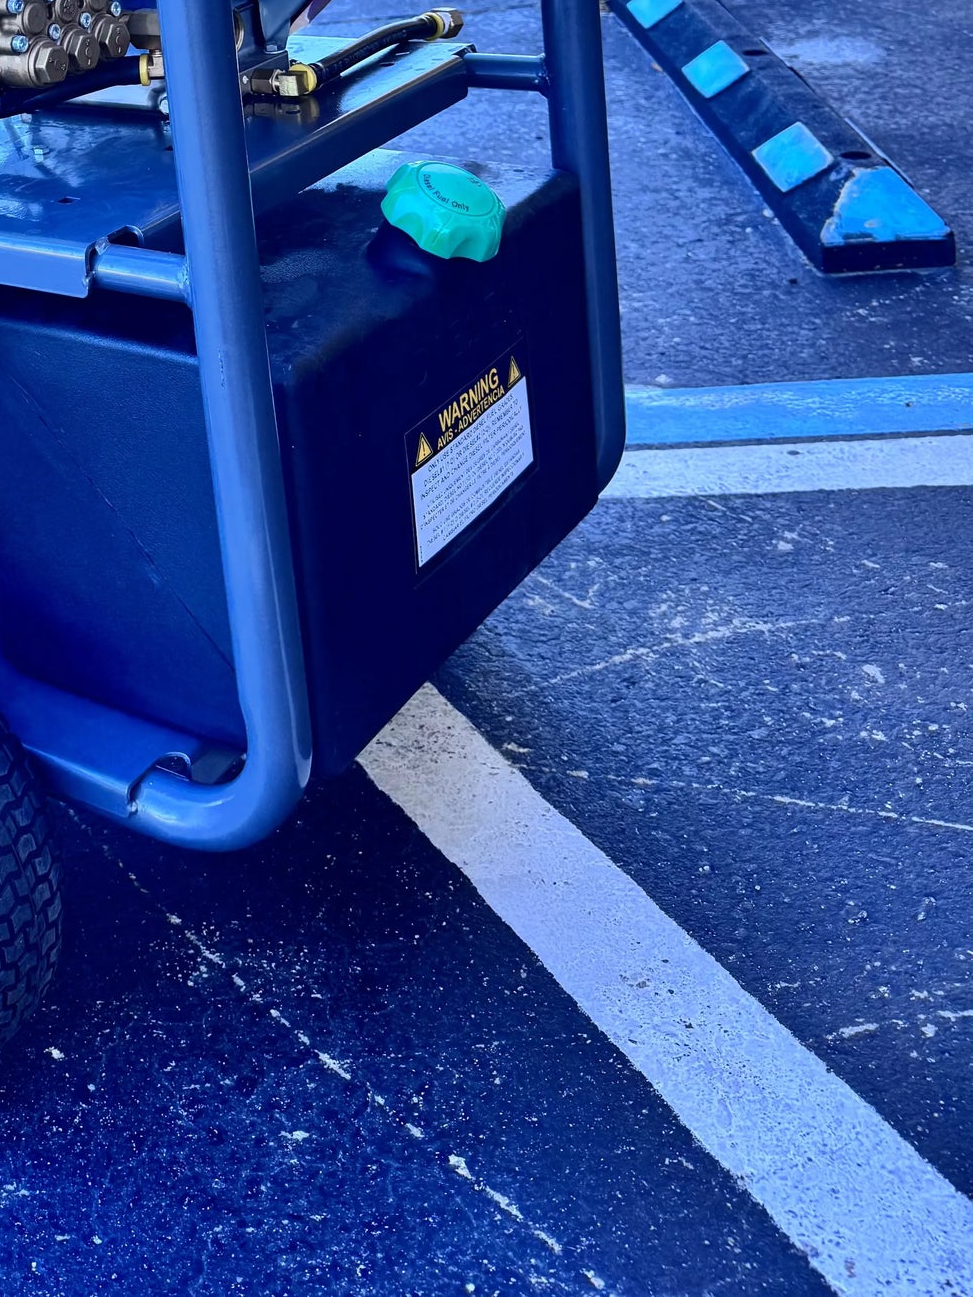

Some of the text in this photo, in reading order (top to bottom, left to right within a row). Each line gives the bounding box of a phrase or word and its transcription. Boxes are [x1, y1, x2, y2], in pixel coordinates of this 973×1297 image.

[433, 190, 450, 203] Fuel
[451, 201, 469, 212] Only
[437, 429, 454, 450] AVIS
[458, 385, 505, 433] ADVERTENCIA
[438, 367, 499, 432] WARNING
